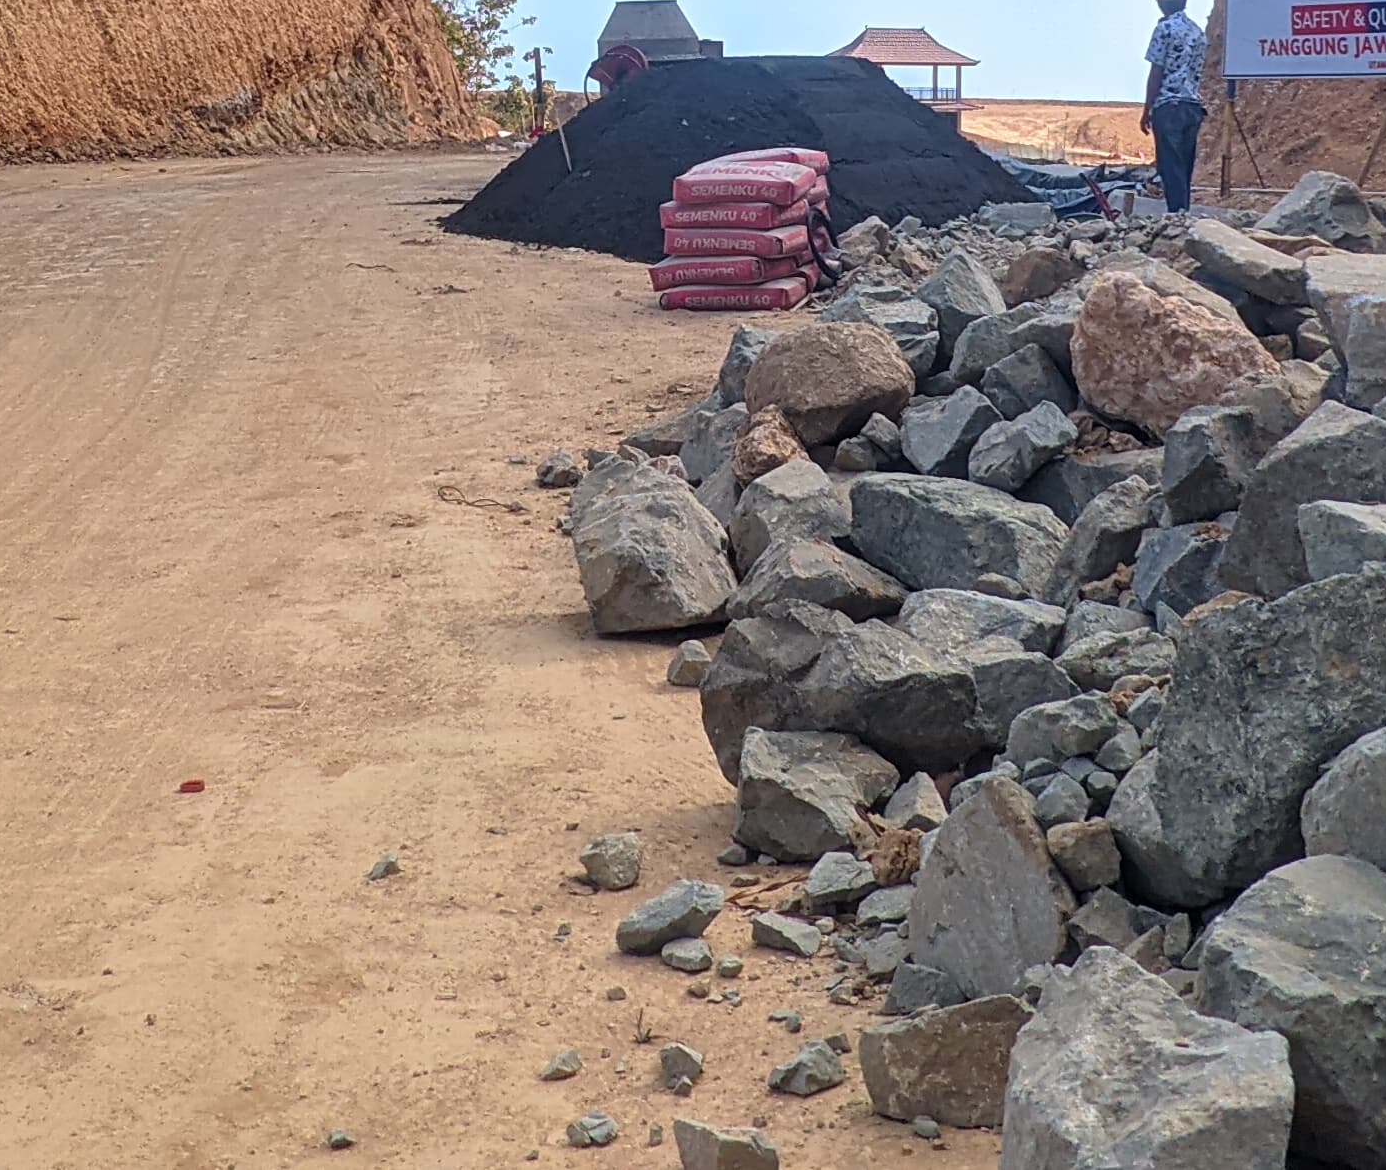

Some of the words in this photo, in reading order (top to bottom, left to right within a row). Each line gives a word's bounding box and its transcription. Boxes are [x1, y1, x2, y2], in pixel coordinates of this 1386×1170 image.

[1293, 9, 1349, 29] SAFETY
[1354, 9, 1365, 27] &
[1259, 38, 1347, 56] TANGGUNG
[692, 185, 756, 196] SEMENKU
[761, 186, 777, 197] 40
[675, 211, 737, 221] SEMENKU
[741, 211, 756, 221] 40
[674, 239, 688, 248] 40
[692, 239, 755, 250] SEMENKU
[685, 295, 748, 306] SEMENKU
[754, 295, 770, 304] 40
